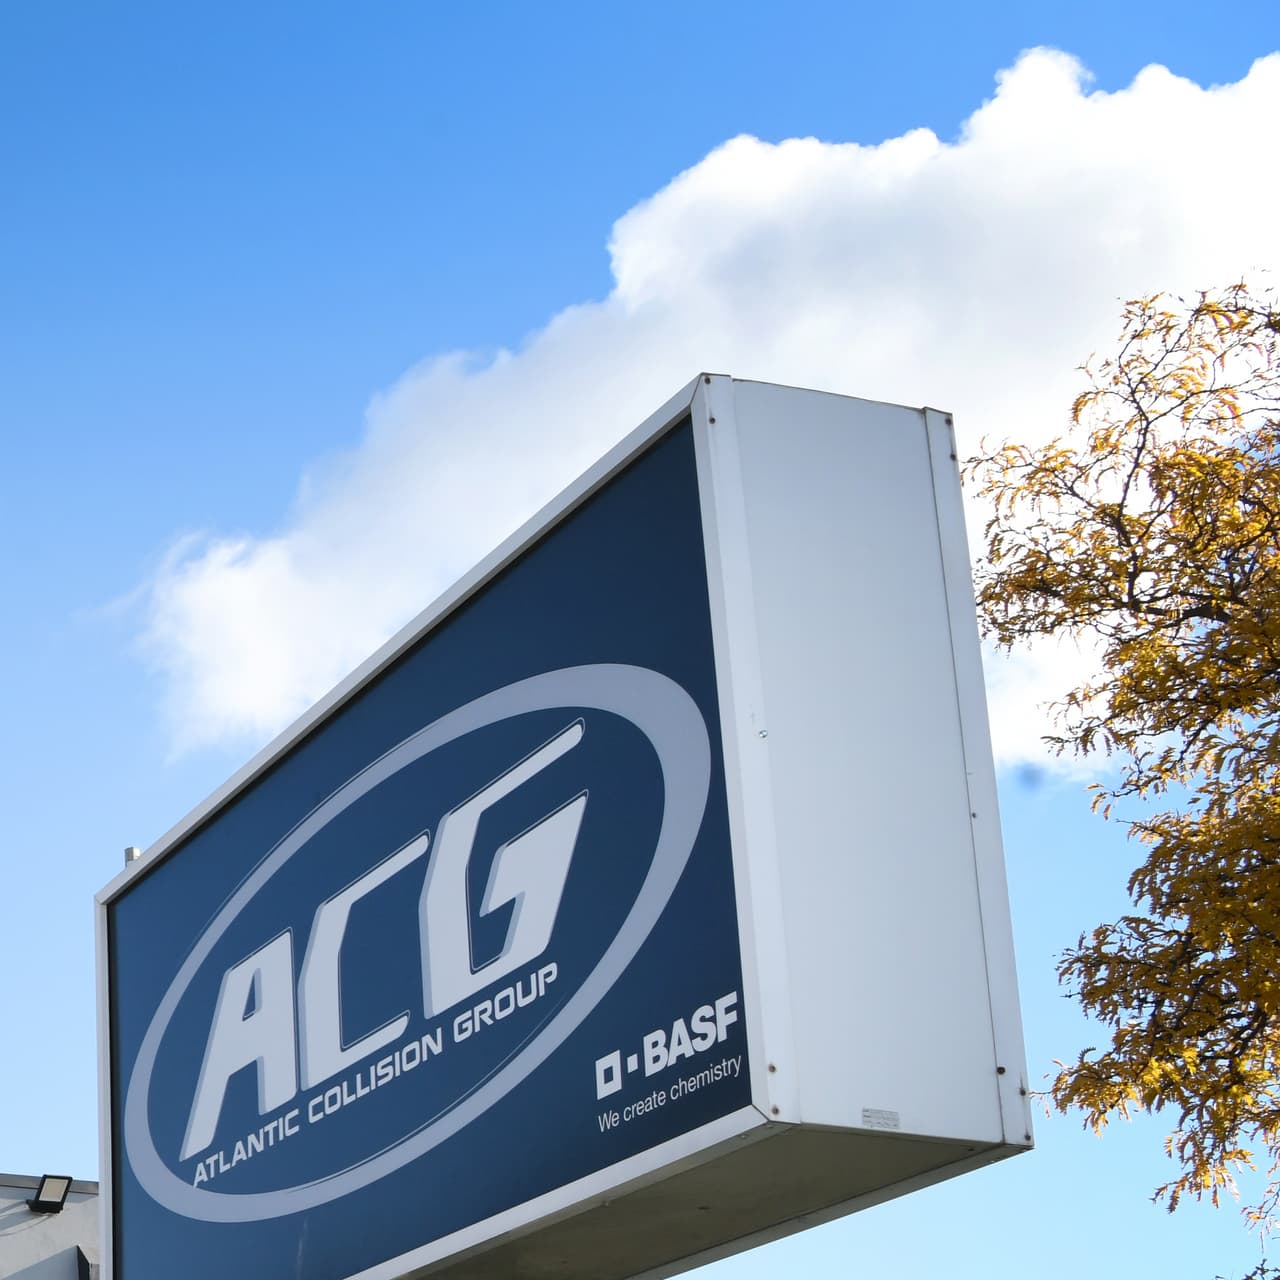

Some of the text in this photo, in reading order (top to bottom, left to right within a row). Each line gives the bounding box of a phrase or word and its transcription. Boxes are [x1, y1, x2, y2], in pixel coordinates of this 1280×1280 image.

[179, 717, 589, 1161] ACG
[193, 961, 558, 1188] ATLANTIC COLLISION GROUP
[597, 1055, 742, 1133] We create chemistry
[642, 990, 738, 1078] BASF
